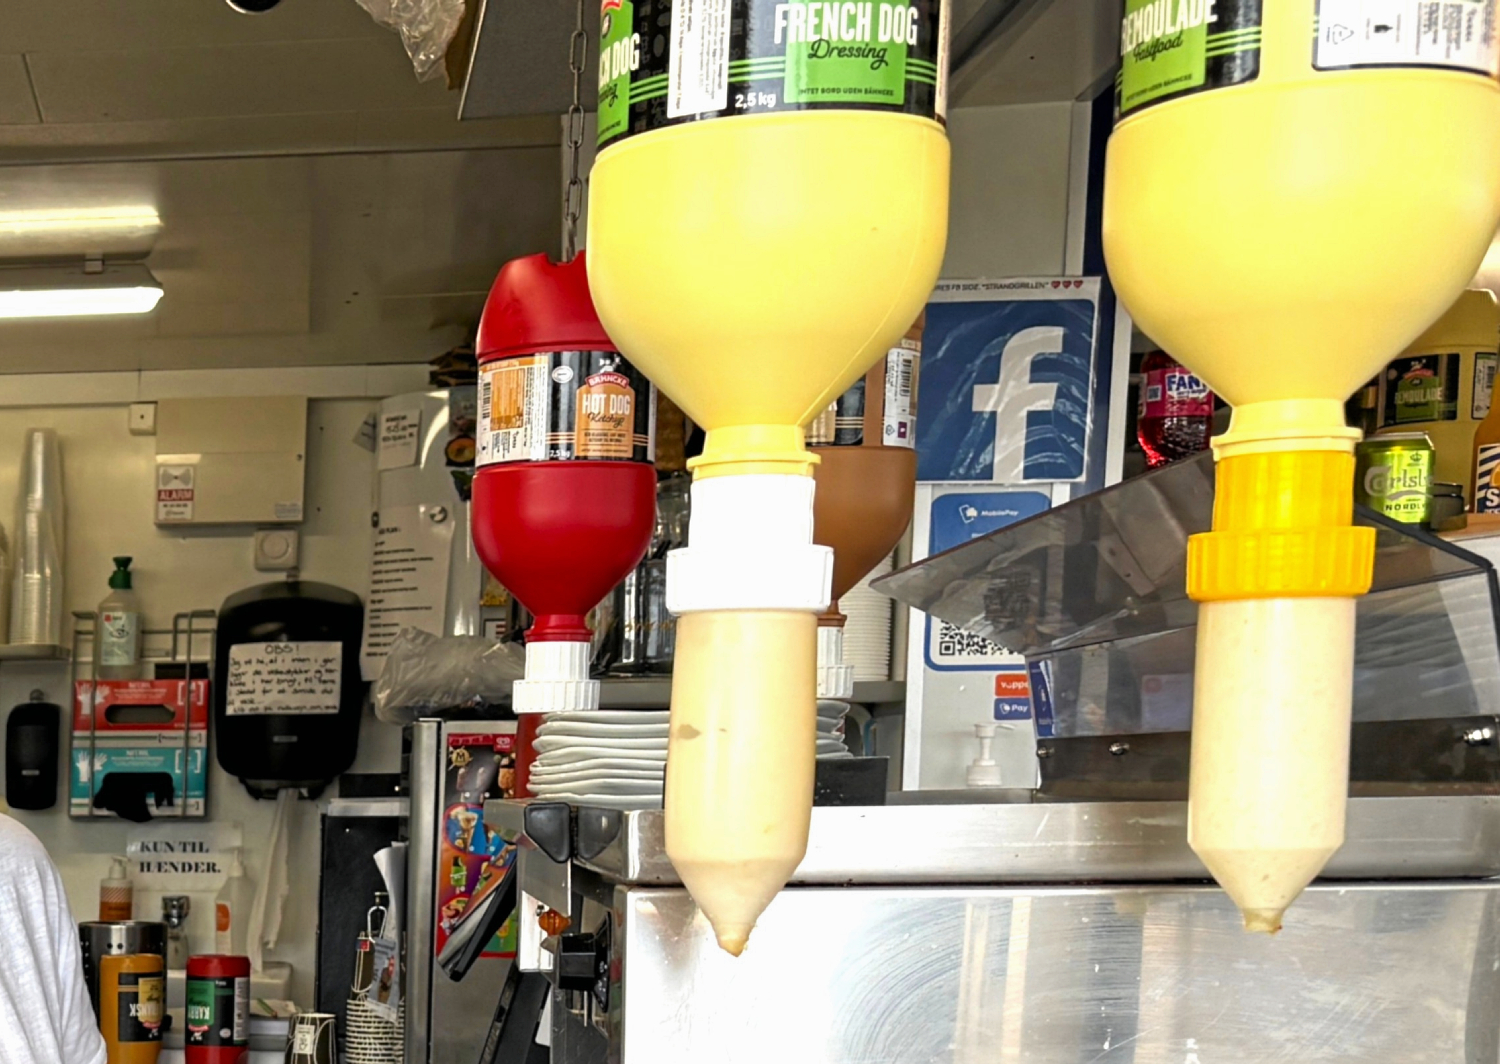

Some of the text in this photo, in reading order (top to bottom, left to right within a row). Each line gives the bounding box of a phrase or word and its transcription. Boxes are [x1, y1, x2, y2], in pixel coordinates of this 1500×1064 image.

[774, 2, 919, 45] FRENCH DOG
[808, 38, 889, 71] Dressing
[1167, 374, 1206, 392] FAN
[582, 394, 631, 415] HOT DOG
[588, 412, 625, 428] Ketchup
[1012, 704, 1028, 712] Pay
[140, 841, 174, 853] KUN
